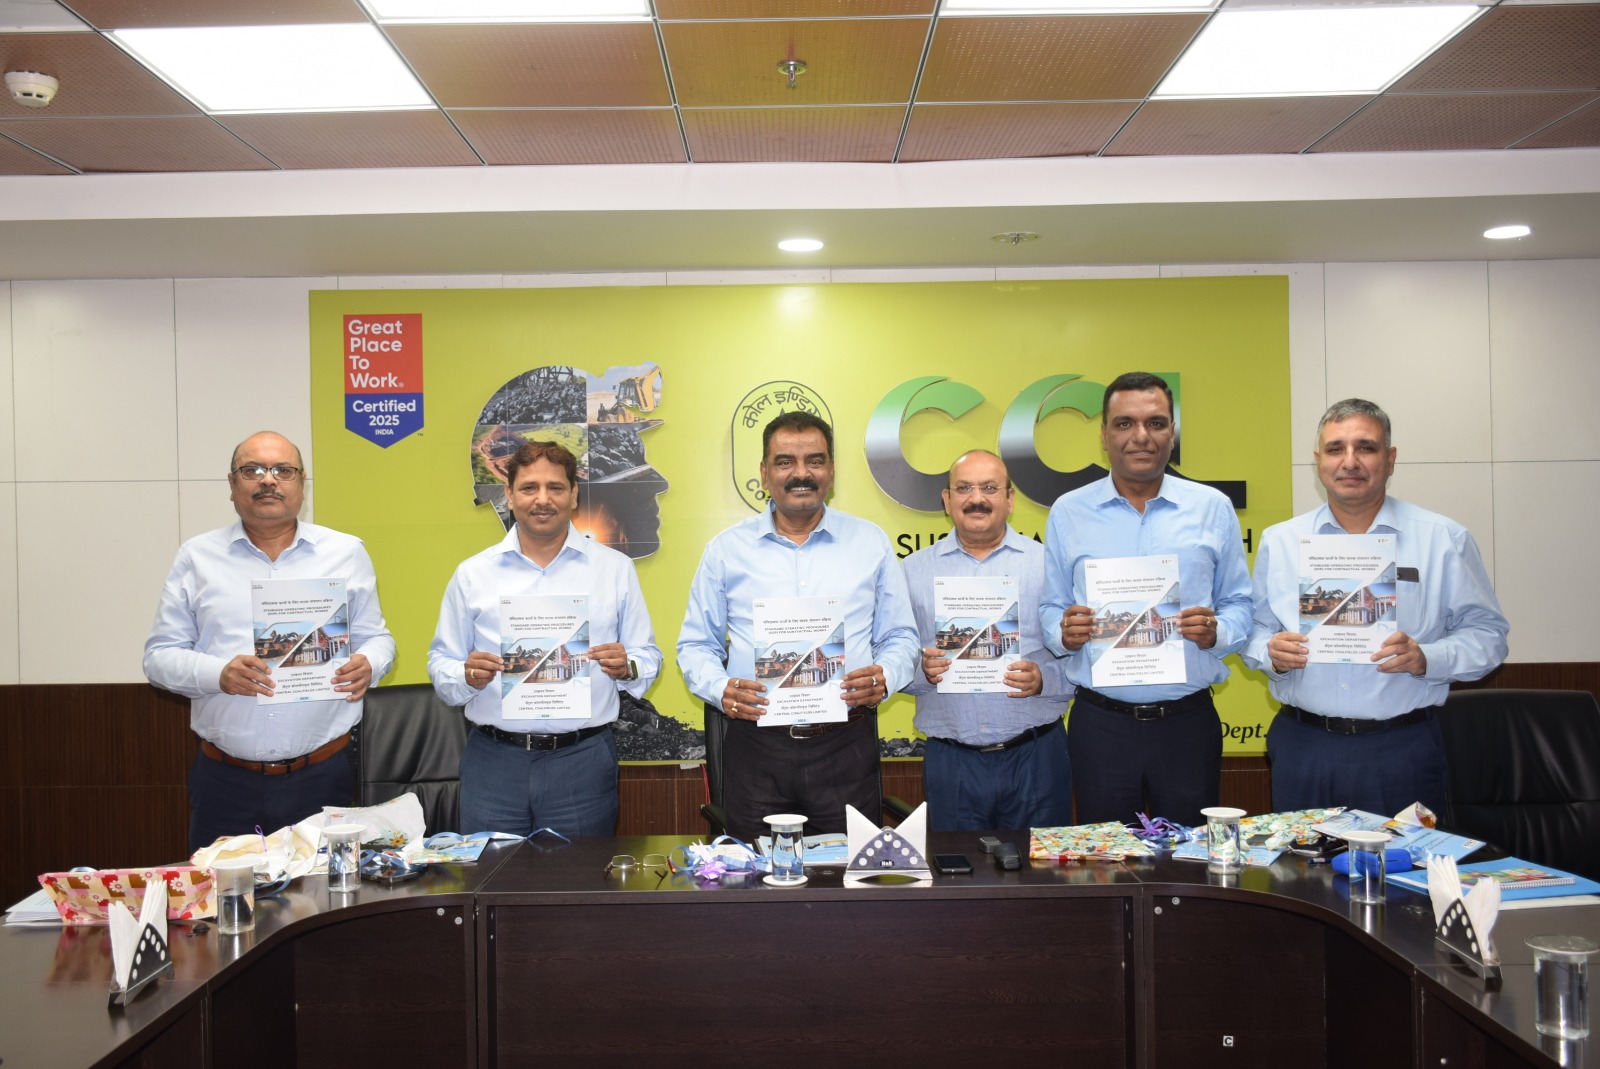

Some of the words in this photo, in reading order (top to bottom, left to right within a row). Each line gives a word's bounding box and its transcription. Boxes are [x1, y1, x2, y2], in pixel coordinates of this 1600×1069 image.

[348, 319, 403, 335] Great
[350, 337, 402, 353] Place
[349, 355, 370, 370] To
[352, 399, 416, 413] Certified
[742, 393, 772, 429] कोल
[369, 415, 400, 426] 2025
[1224, 1036, 1232, 1046] C
